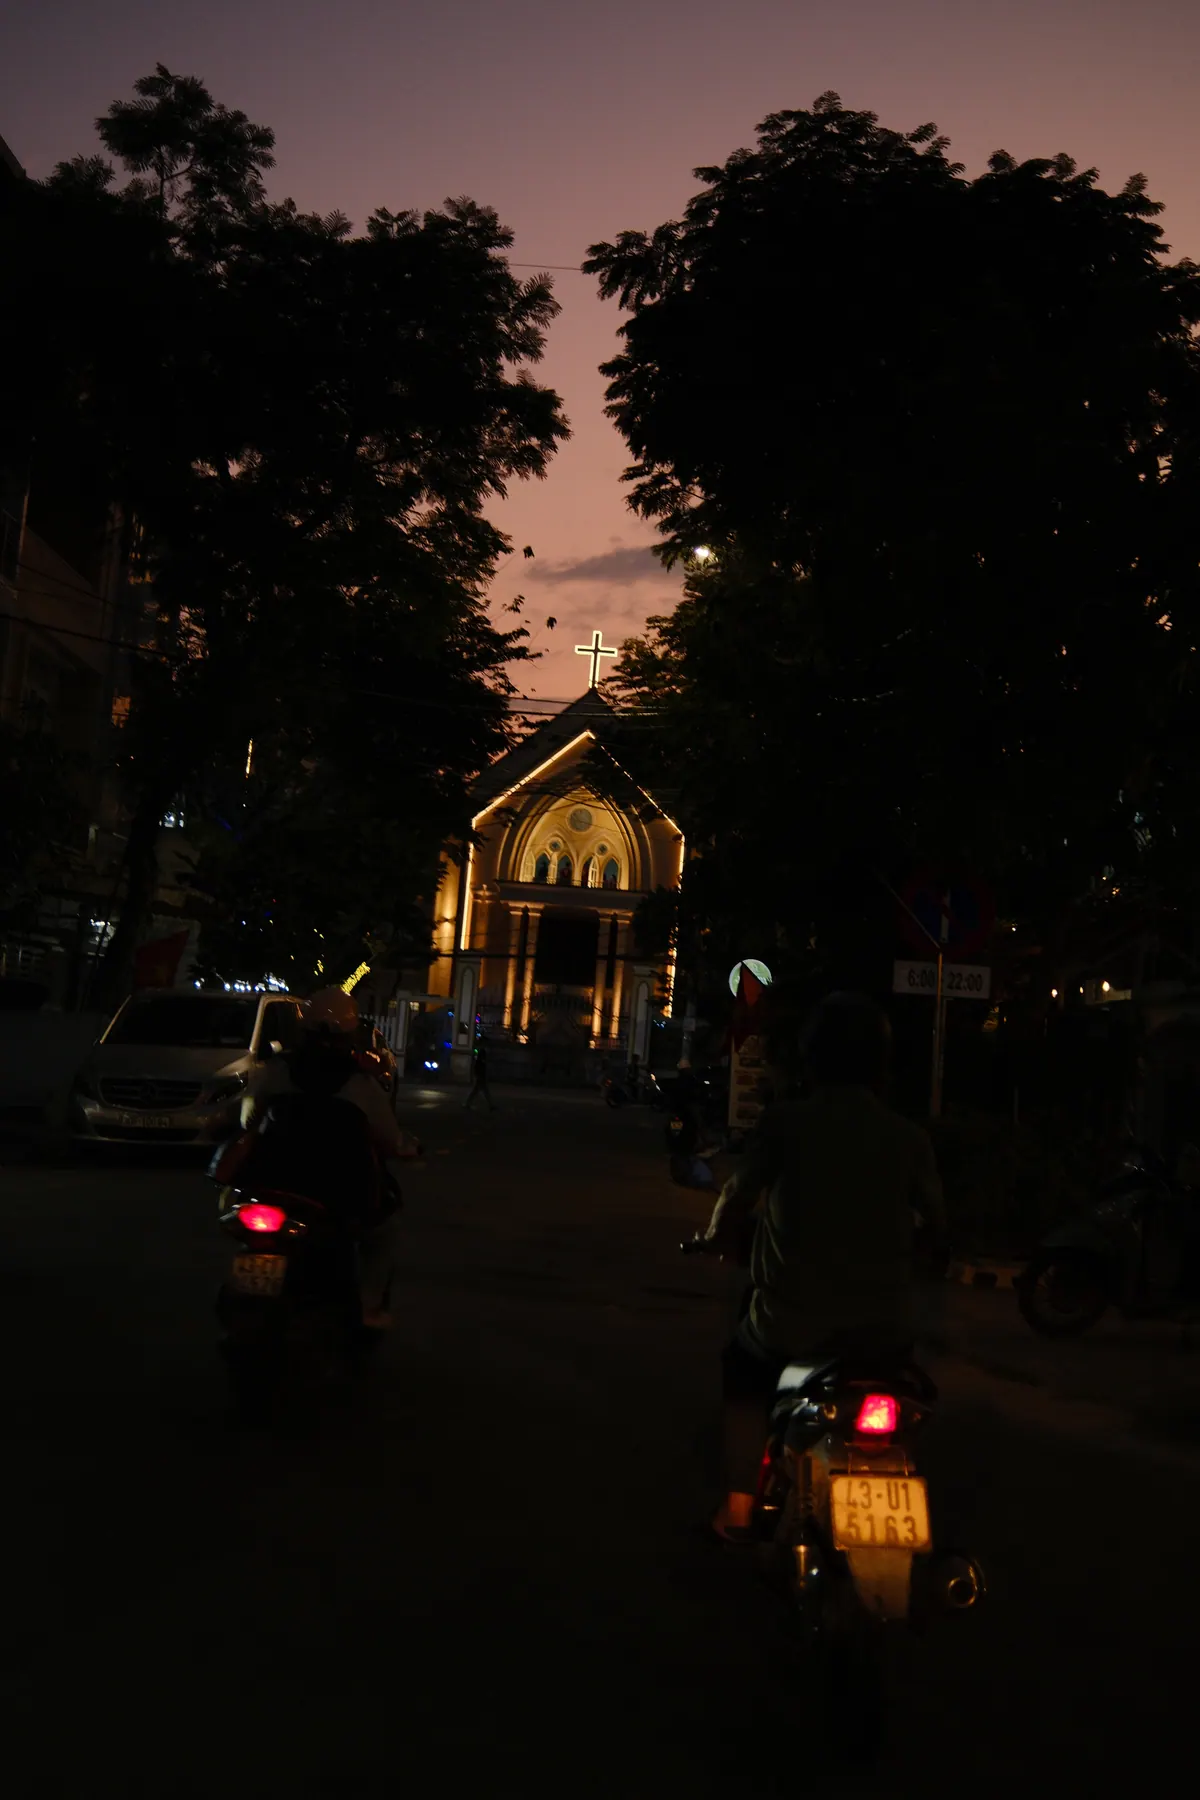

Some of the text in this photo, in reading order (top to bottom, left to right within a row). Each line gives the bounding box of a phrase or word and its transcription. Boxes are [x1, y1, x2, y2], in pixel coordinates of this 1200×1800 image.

[908, 969, 984, 992] 6:00 22:00
[846, 1511, 918, 1544] 5163
